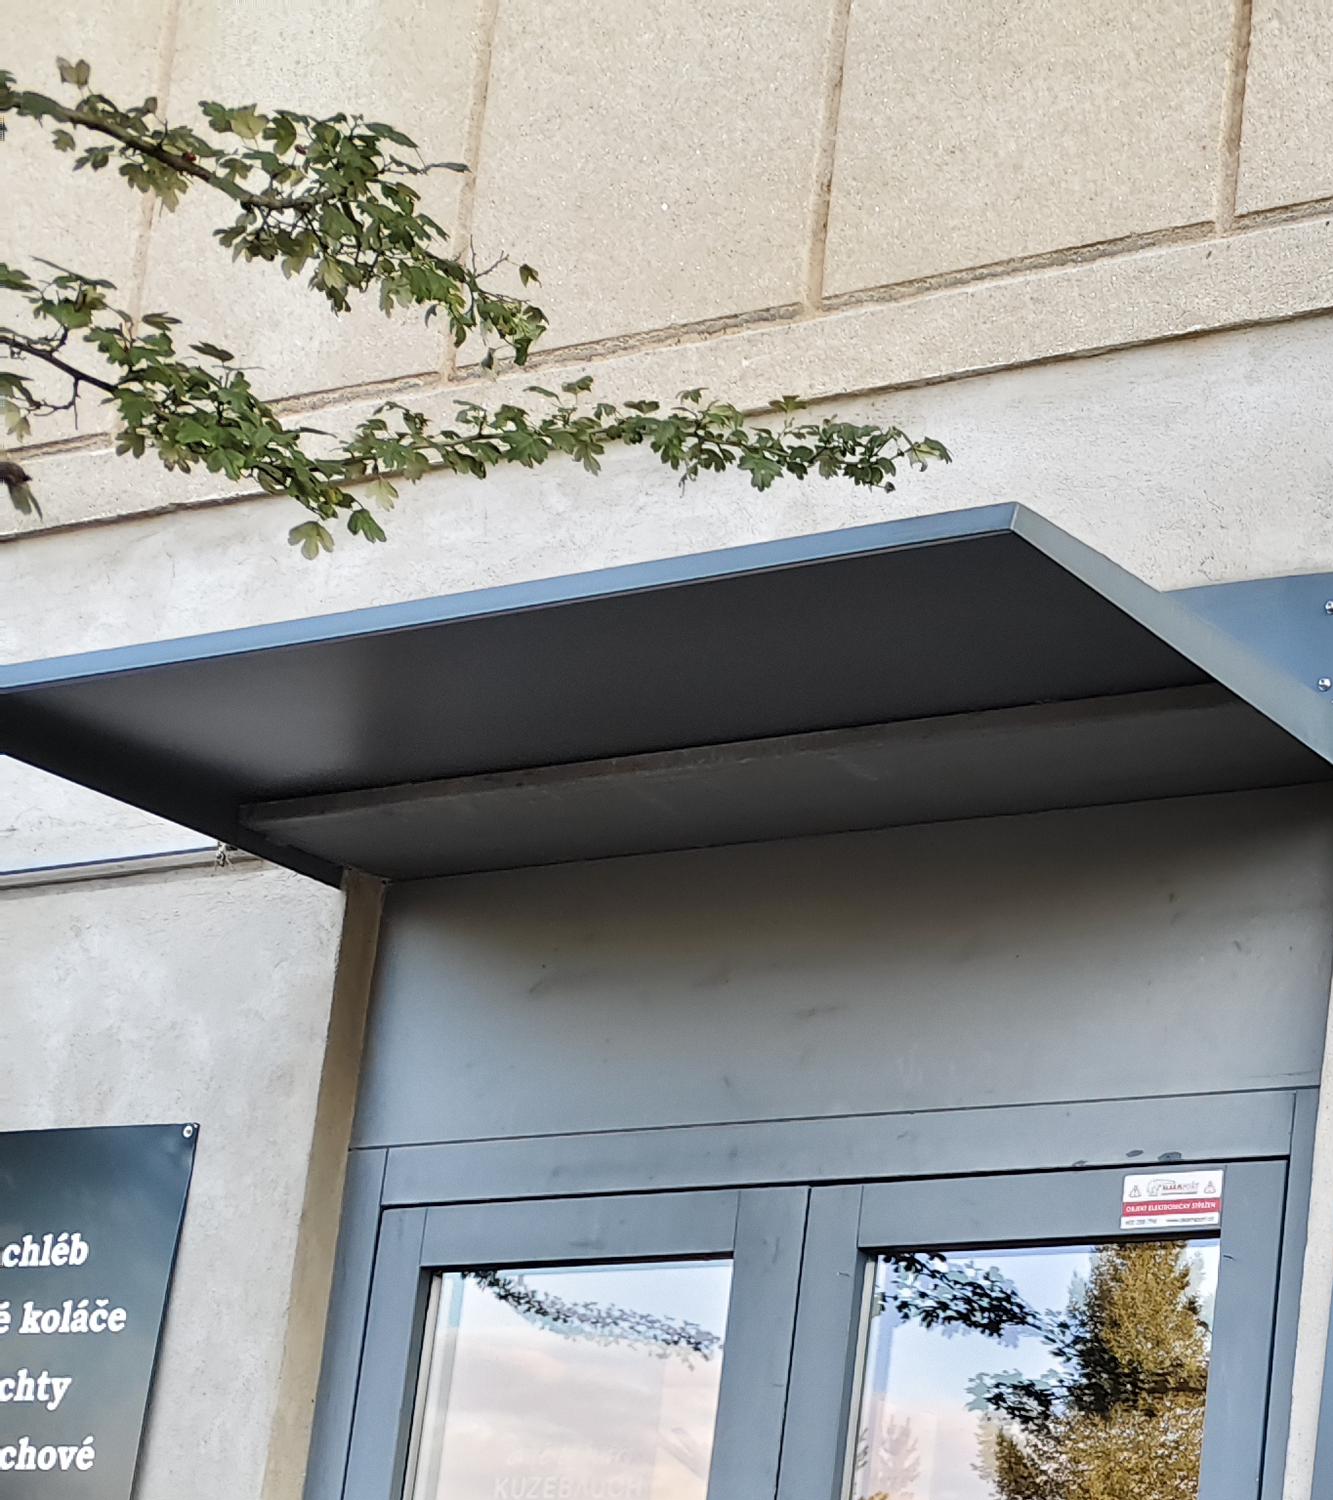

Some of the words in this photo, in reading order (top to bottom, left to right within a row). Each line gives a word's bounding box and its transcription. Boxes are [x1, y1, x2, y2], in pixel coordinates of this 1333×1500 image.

[2, 1232, 89, 1268] chléb
[18, 1299, 127, 1334] koláče
[0, 1368, 72, 1411] chty
[0, 1435, 96, 1471] chové
